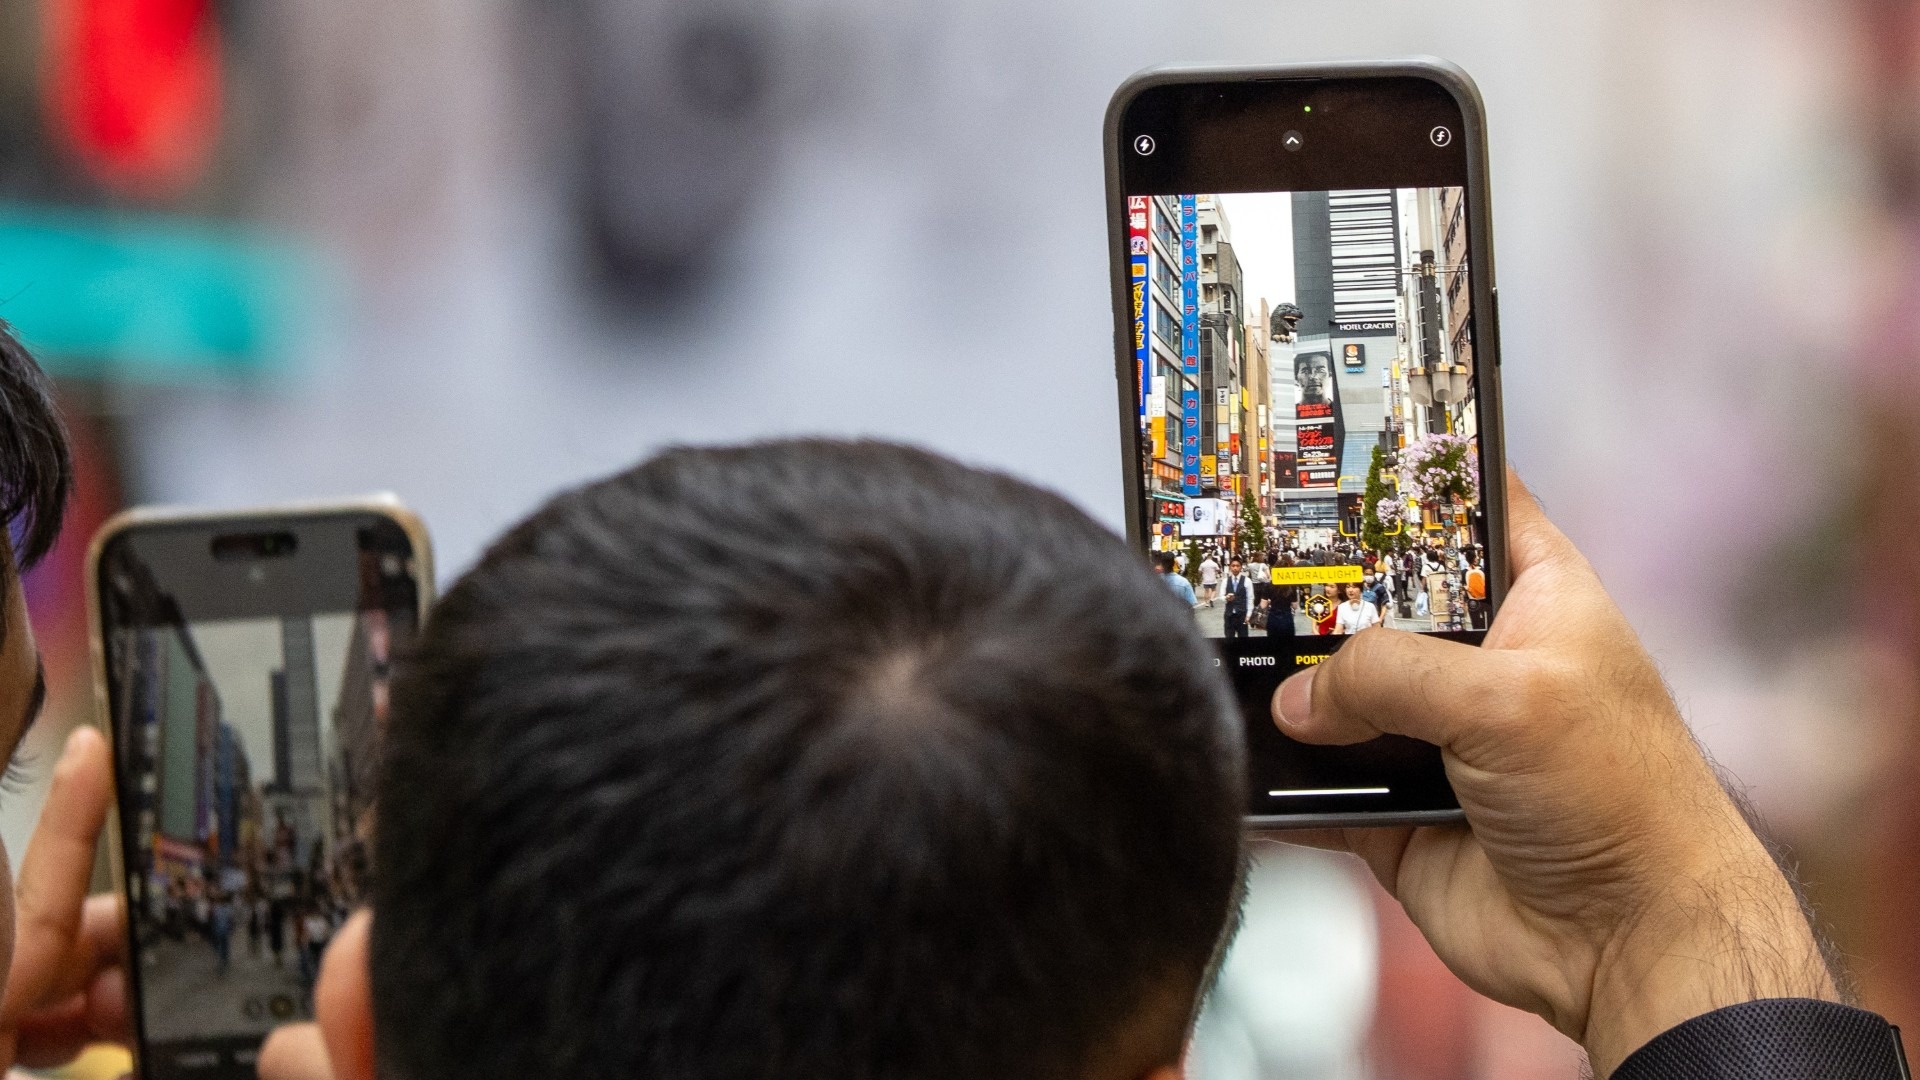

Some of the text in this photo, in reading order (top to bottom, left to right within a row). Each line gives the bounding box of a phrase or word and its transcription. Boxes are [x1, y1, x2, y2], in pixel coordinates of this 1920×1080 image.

[1340, 322, 1394, 331] HOTEL GRACERY
[1277, 569, 1357, 580] NATURAL LIGHT
[1239, 656, 1275, 667] PHOTO
